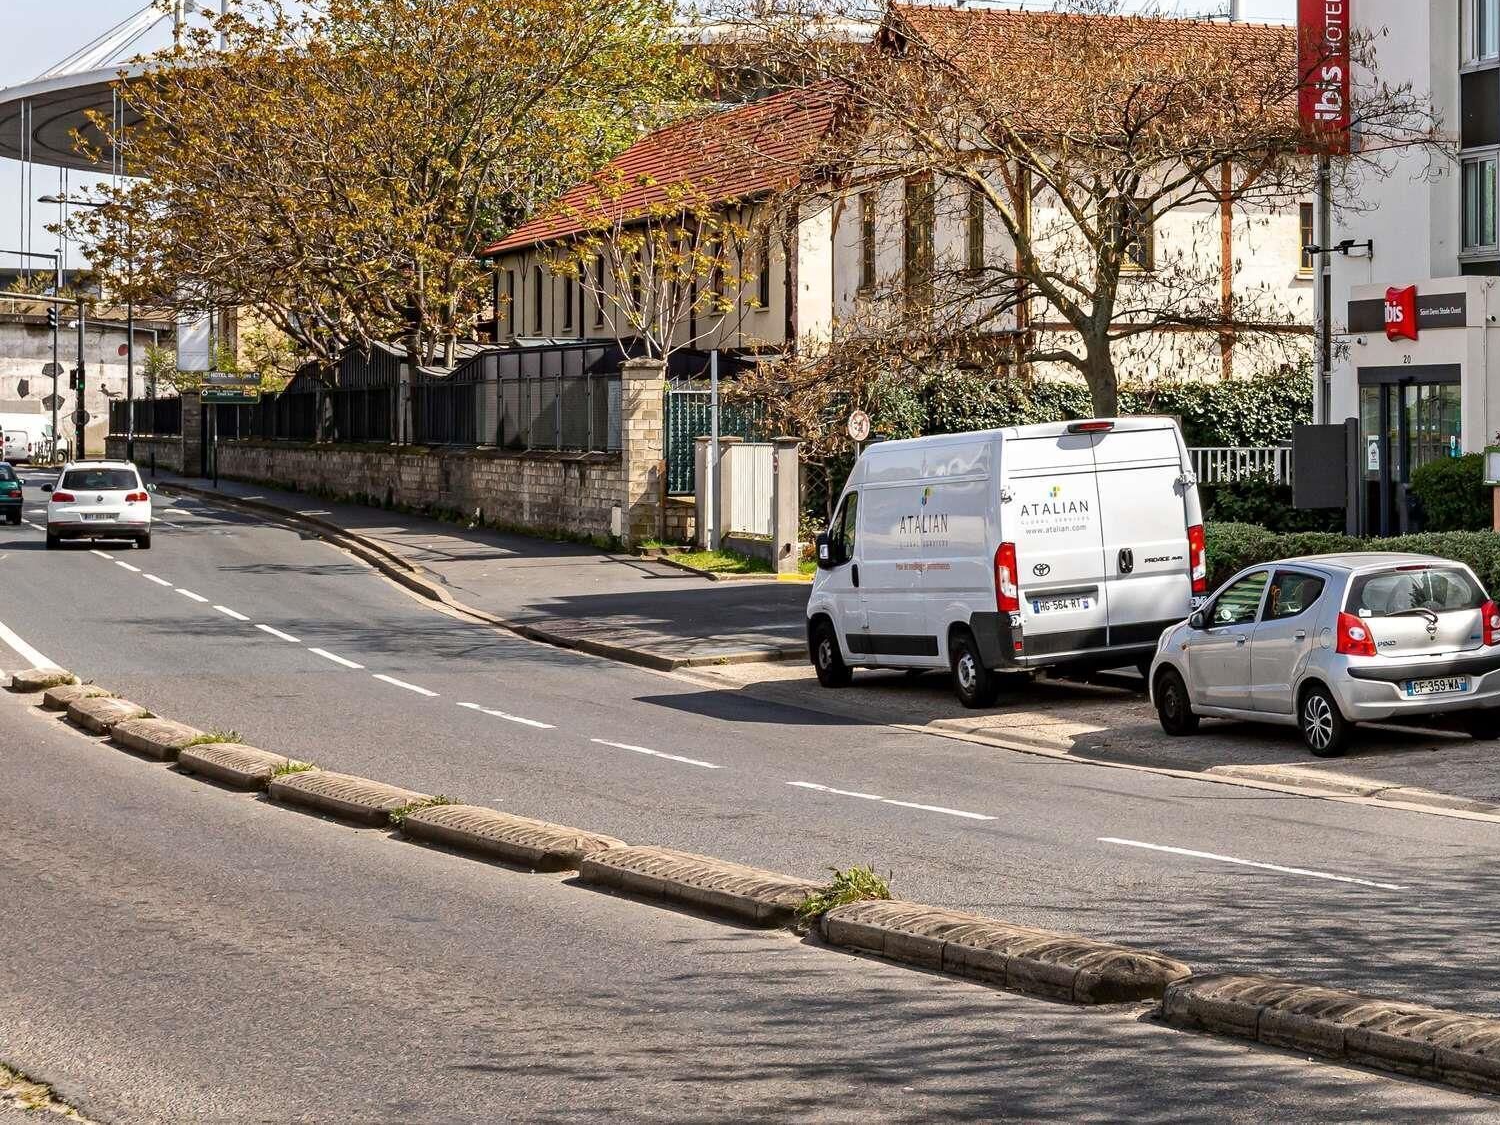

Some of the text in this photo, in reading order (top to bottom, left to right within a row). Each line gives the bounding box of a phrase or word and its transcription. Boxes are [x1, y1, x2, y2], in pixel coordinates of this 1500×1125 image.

[1314, 66, 1342, 121] ibis
[1384, 300, 1404, 323] ibis
[1403, 355, 1412, 364] 20
[1021, 500, 1089, 516] ATALIAN
[899, 513, 949, 535] ATALIAN
[1026, 524, 1087, 535] www.atalian.com
[1039, 598, 1081, 612] HG-564-RT
[1413, 678, 1461, 694] CF-359-WA
